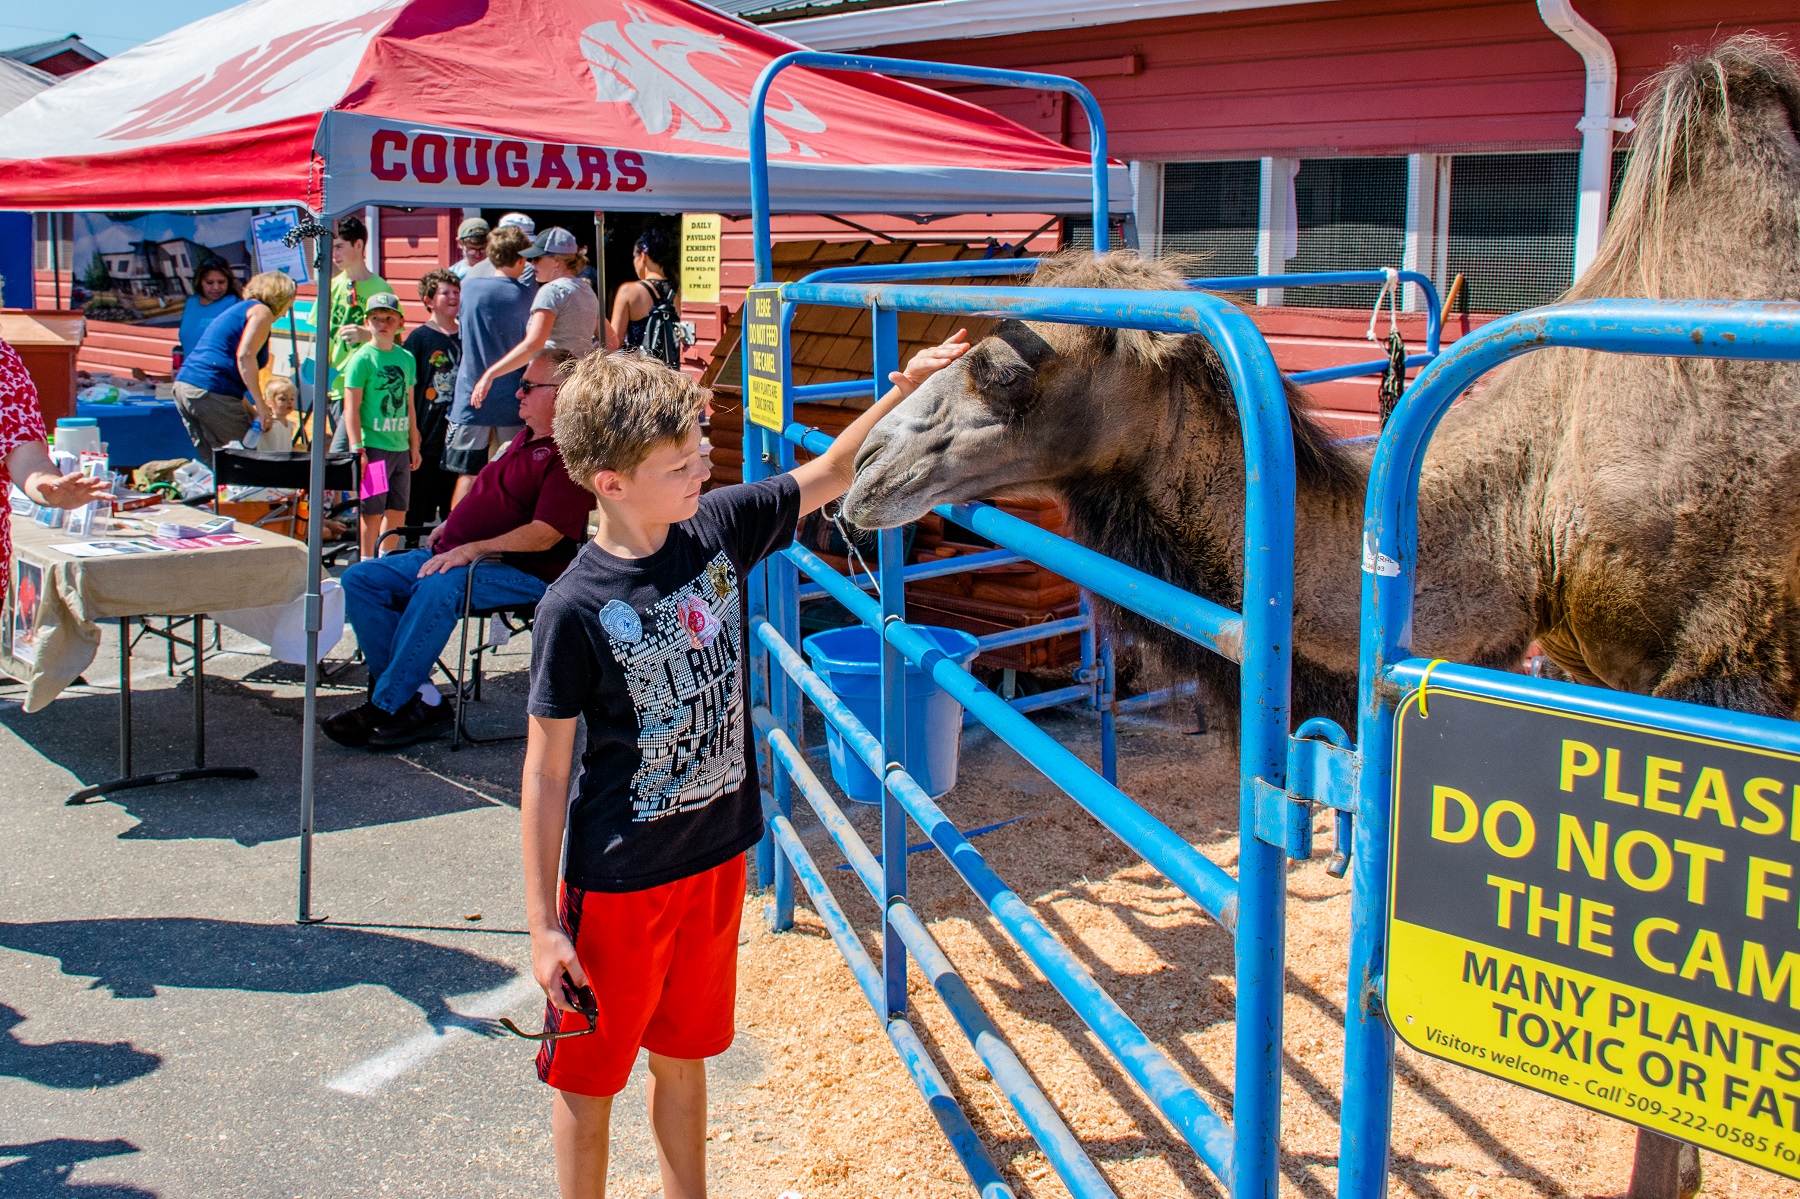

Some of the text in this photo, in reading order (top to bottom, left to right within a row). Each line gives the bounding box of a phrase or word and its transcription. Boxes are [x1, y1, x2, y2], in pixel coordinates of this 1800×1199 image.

[370, 129, 648, 192] COUGARS
[749, 323, 779, 347] DO NOT FEED
[755, 297, 771, 318] PLEASE
[752, 350, 776, 374] THE CAMEL
[373, 417, 410, 432] LATER
[1559, 739, 1800, 842] PLEAS
[1430, 784, 1800, 929] DO NOT F
[1486, 874, 1615, 958] THE
[1461, 950, 1800, 1083] MANY PLANTS
[1492, 1001, 1624, 1075] TOXIC
[1637, 1050, 1707, 1103] OR
[1425, 1025, 1487, 1059] Visitors
[1491, 1050, 1570, 1086] welcome
[1585, 1079, 1622, 1103] Call
[1625, 1090, 1769, 1153] 509-222-0585
[1774, 1141, 1800, 1164] fo
